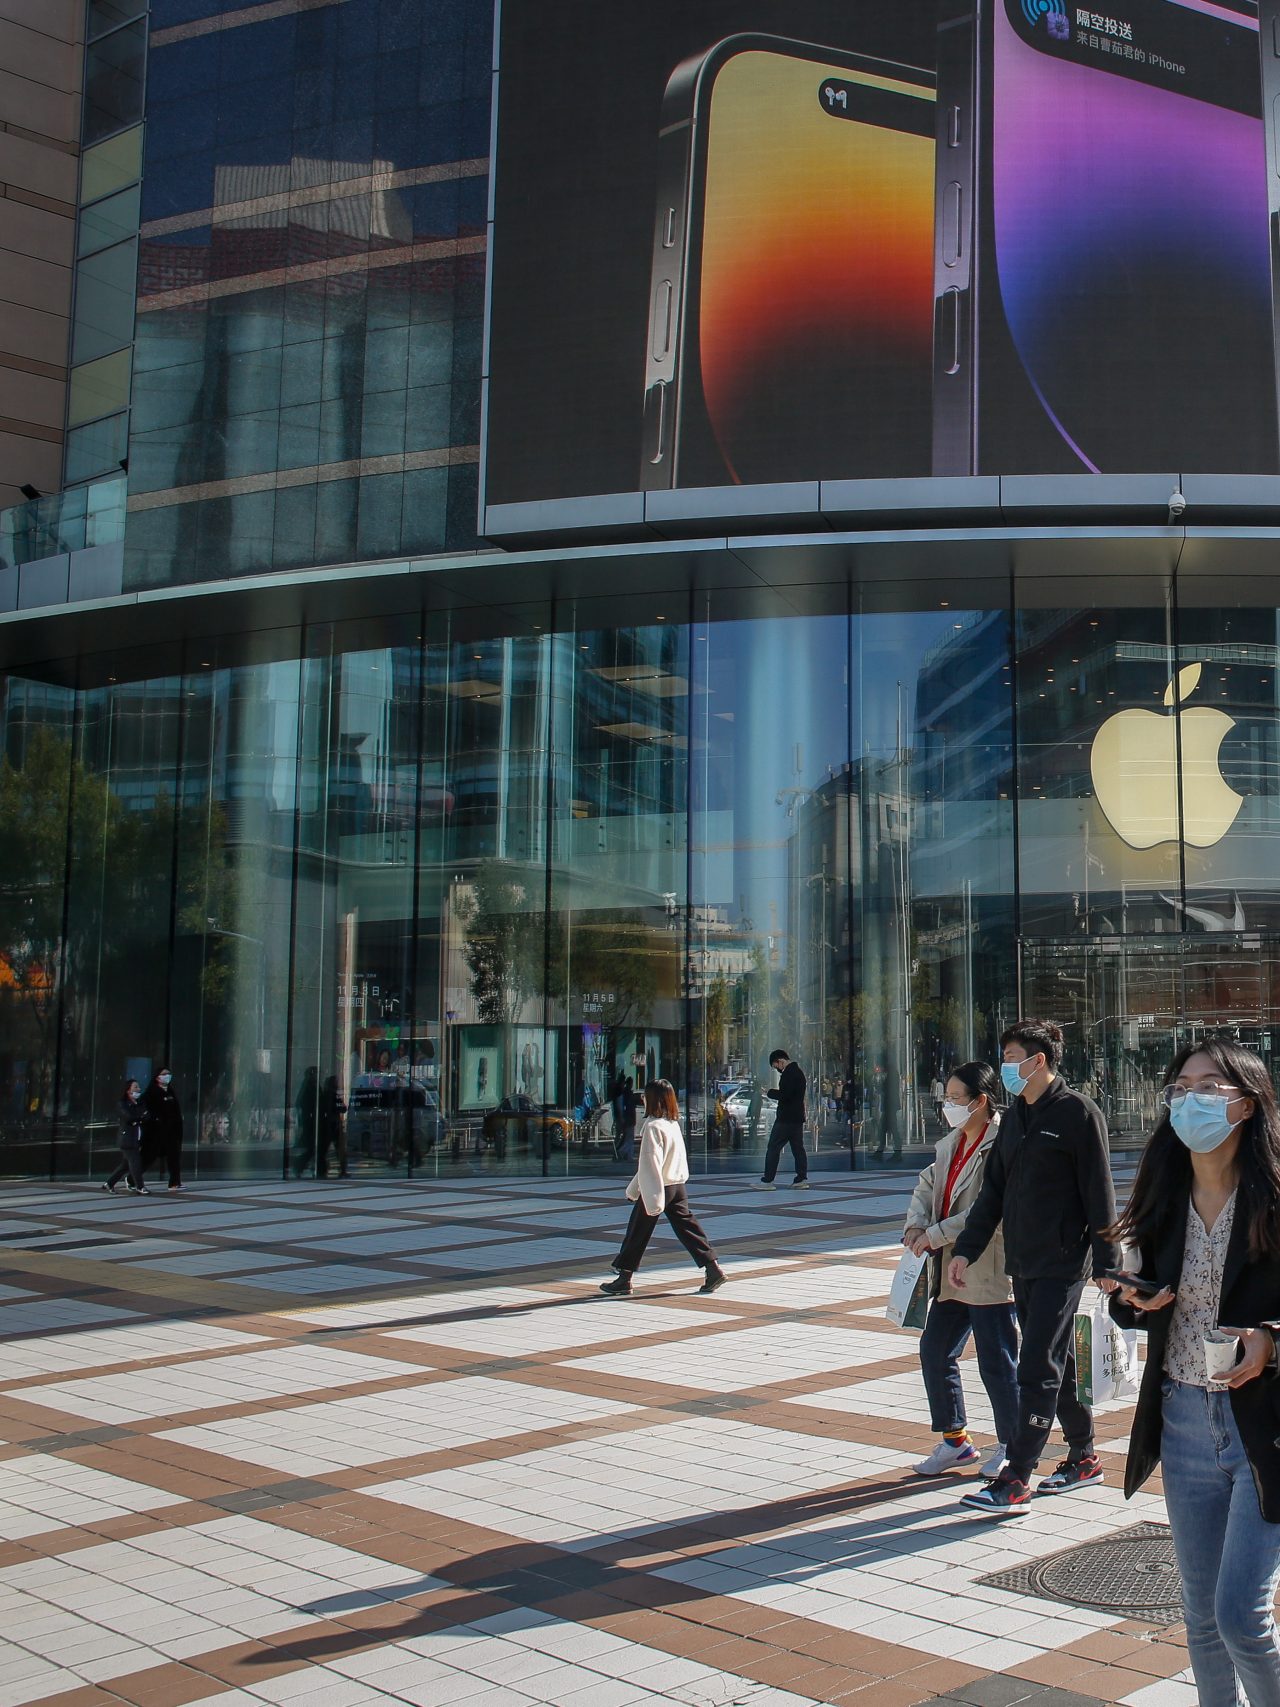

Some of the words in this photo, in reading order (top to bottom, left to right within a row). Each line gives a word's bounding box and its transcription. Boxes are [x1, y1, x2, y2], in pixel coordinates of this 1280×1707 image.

[1076, 8, 1133, 41] 隔空投送
[1076, 30, 1146, 63] 来自曹茹君的
[1148, 52, 1186, 75] iPhone
[1102, 1332, 1121, 1344] TOU
[1102, 1361, 1130, 1379] 多乐之日
